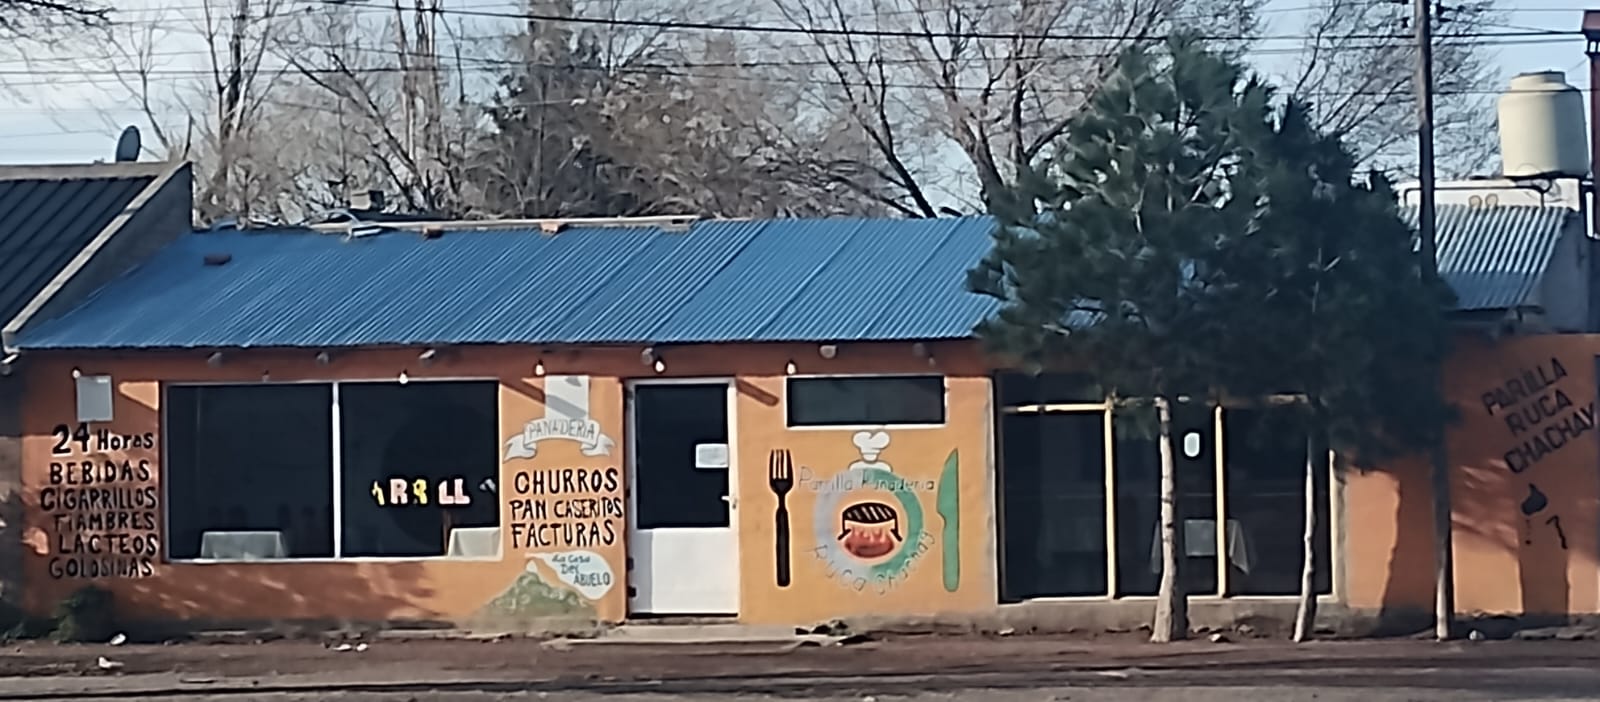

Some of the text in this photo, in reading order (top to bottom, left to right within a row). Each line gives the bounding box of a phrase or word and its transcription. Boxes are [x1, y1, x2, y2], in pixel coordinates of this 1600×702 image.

[1505, 389, 1573, 436] RUCA
[52, 423, 154, 454] 24 Horas
[1503, 402, 1594, 474] CHACHAY
[50, 459, 151, 485] BEBIDAS
[514, 467, 619, 494] CHURROS
[509, 497, 624, 521] PAN CASERITOS
[58, 533, 159, 556] LACTEOS
[511, 519, 616, 549] FACTURAS
[50, 556, 153, 579] GOLOSINAS
